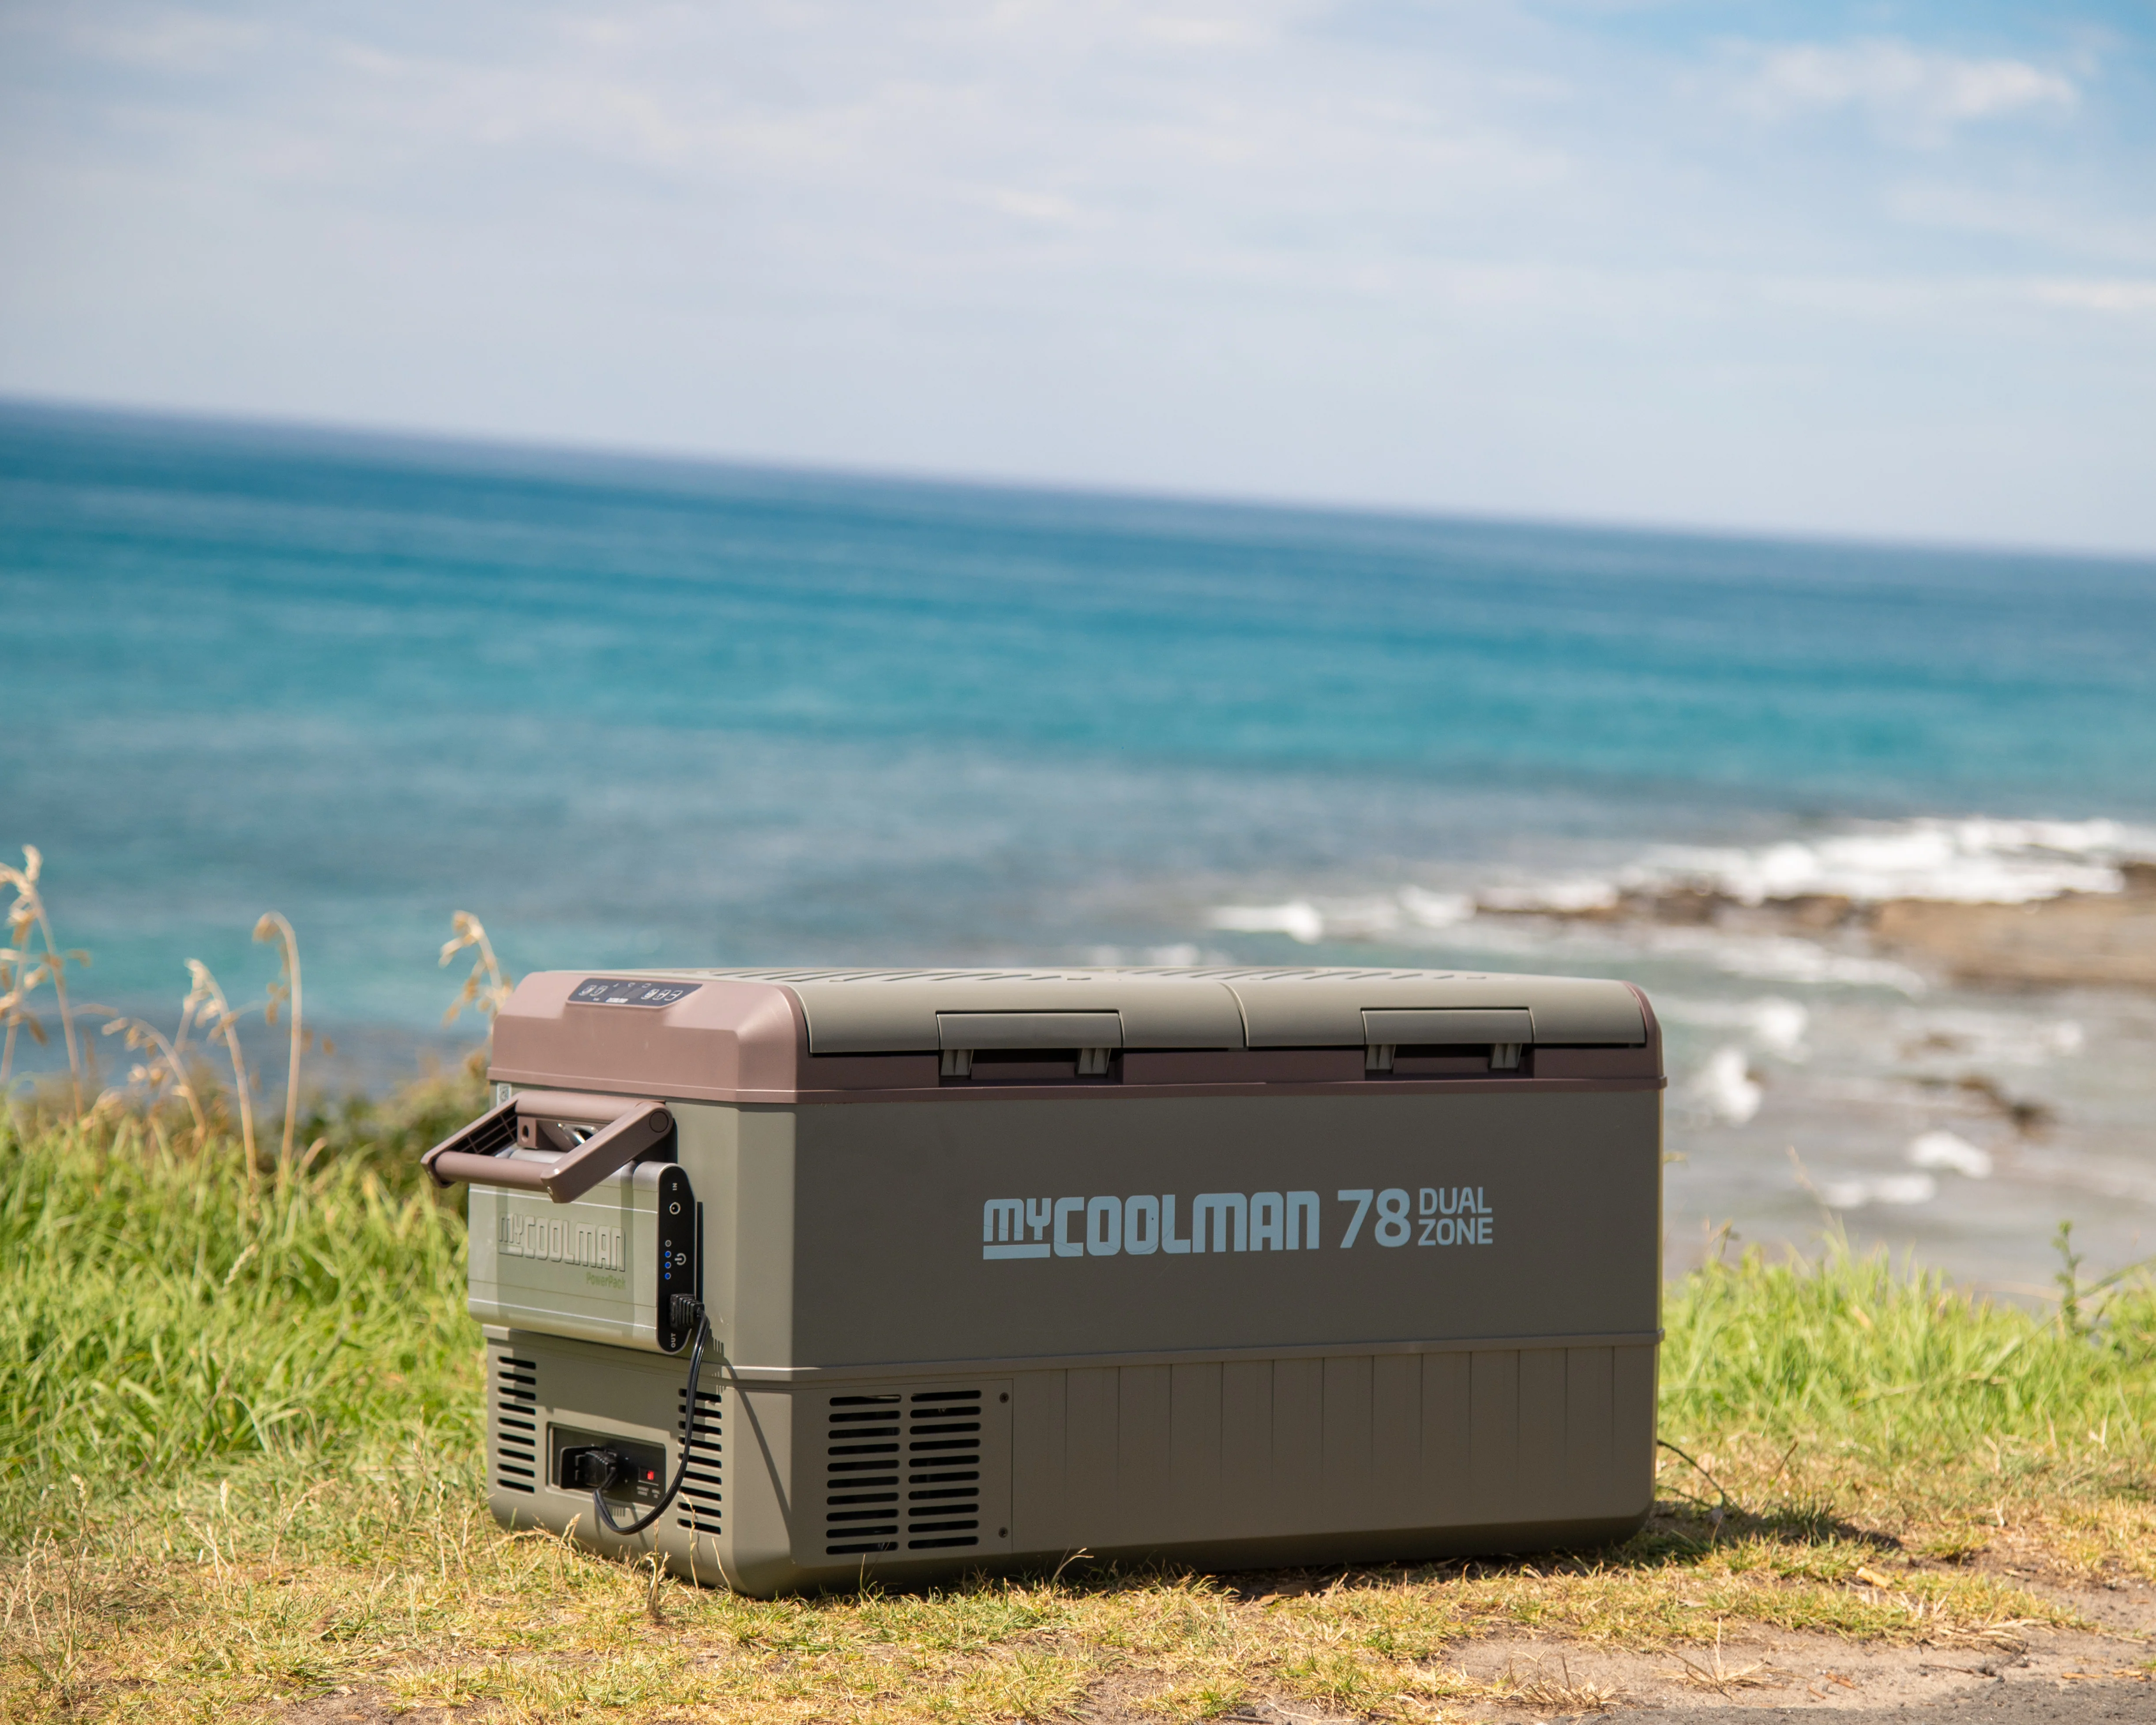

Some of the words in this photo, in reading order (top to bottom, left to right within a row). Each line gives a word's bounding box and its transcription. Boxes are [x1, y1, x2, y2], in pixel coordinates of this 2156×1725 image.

[1337, 1188, 1411, 1249] 78
[1419, 1187, 1492, 1216] DUAL
[1418, 1216, 1493, 1246] ZONE
[586, 1272, 626, 1289] PowerPack
